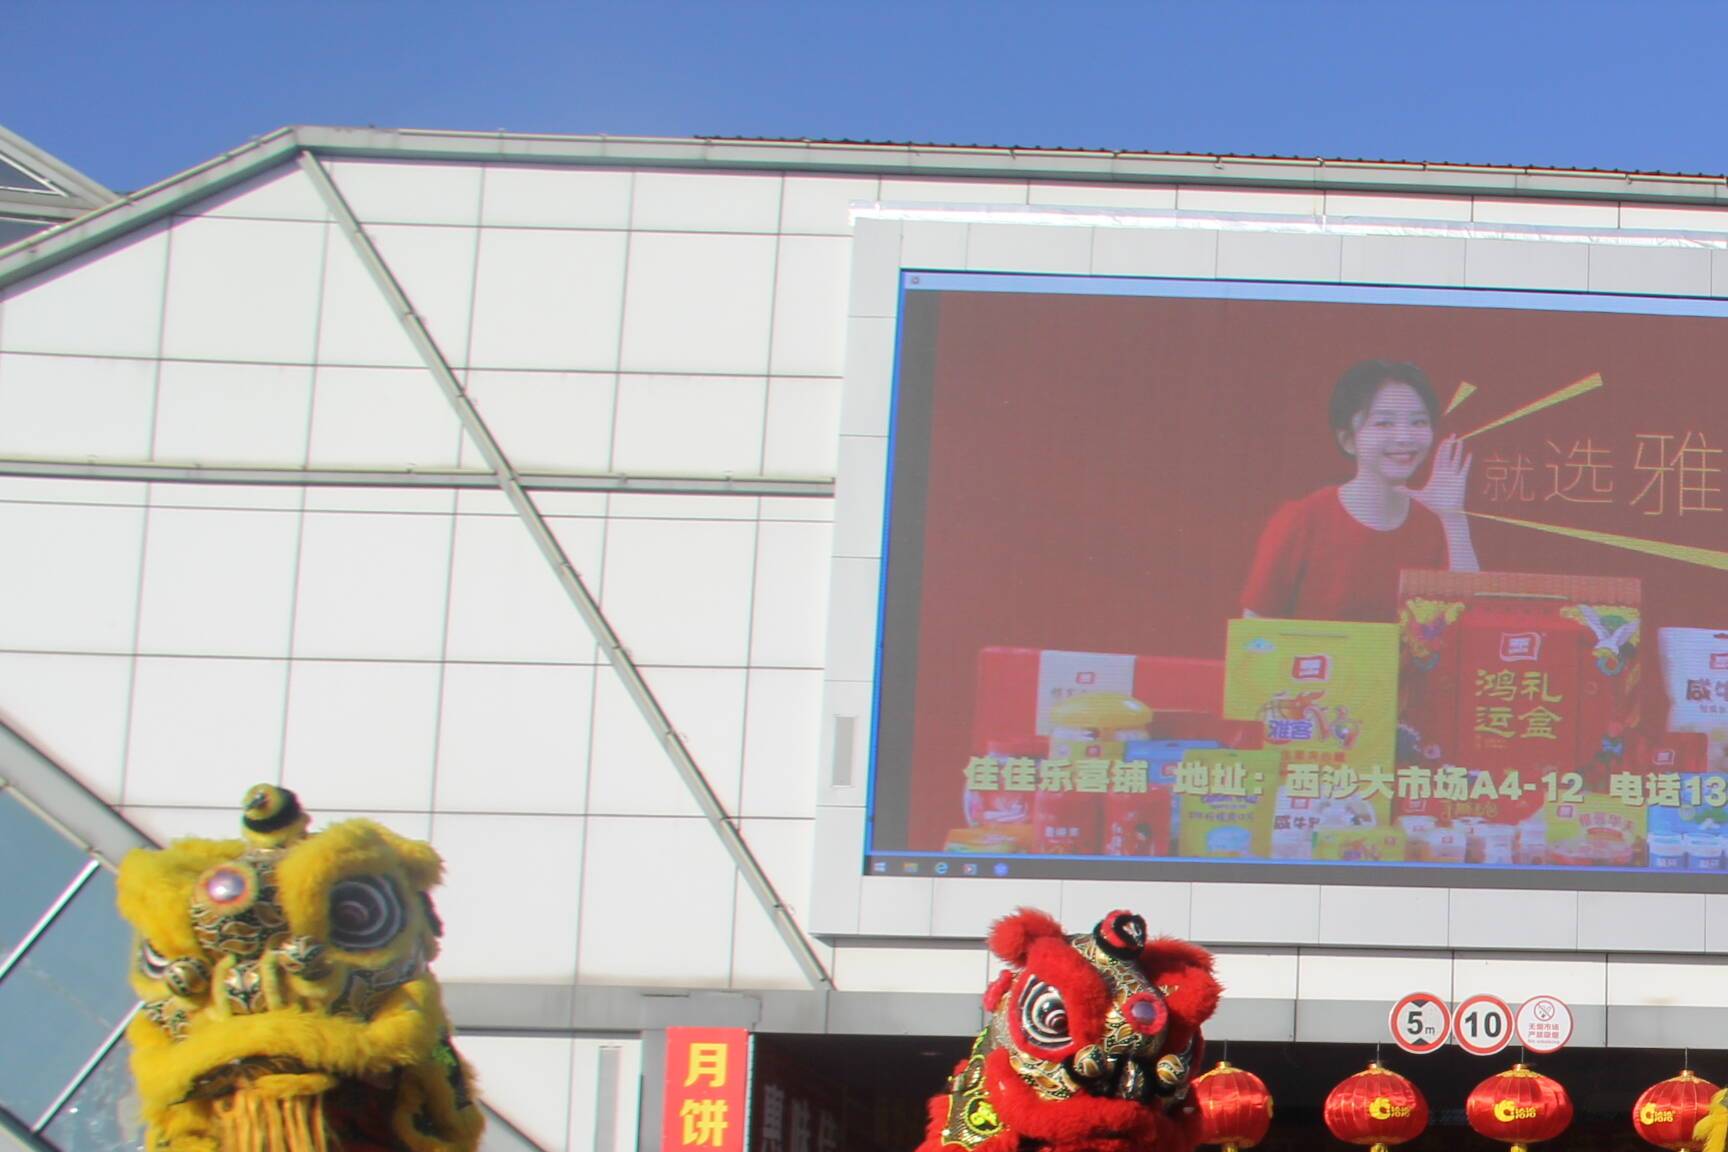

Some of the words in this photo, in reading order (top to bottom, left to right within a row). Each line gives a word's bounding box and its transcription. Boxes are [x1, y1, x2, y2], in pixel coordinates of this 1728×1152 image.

[963, 755, 1149, 793] 佳佳乐喜铺
[1465, 1012, 1500, 1037] 10
